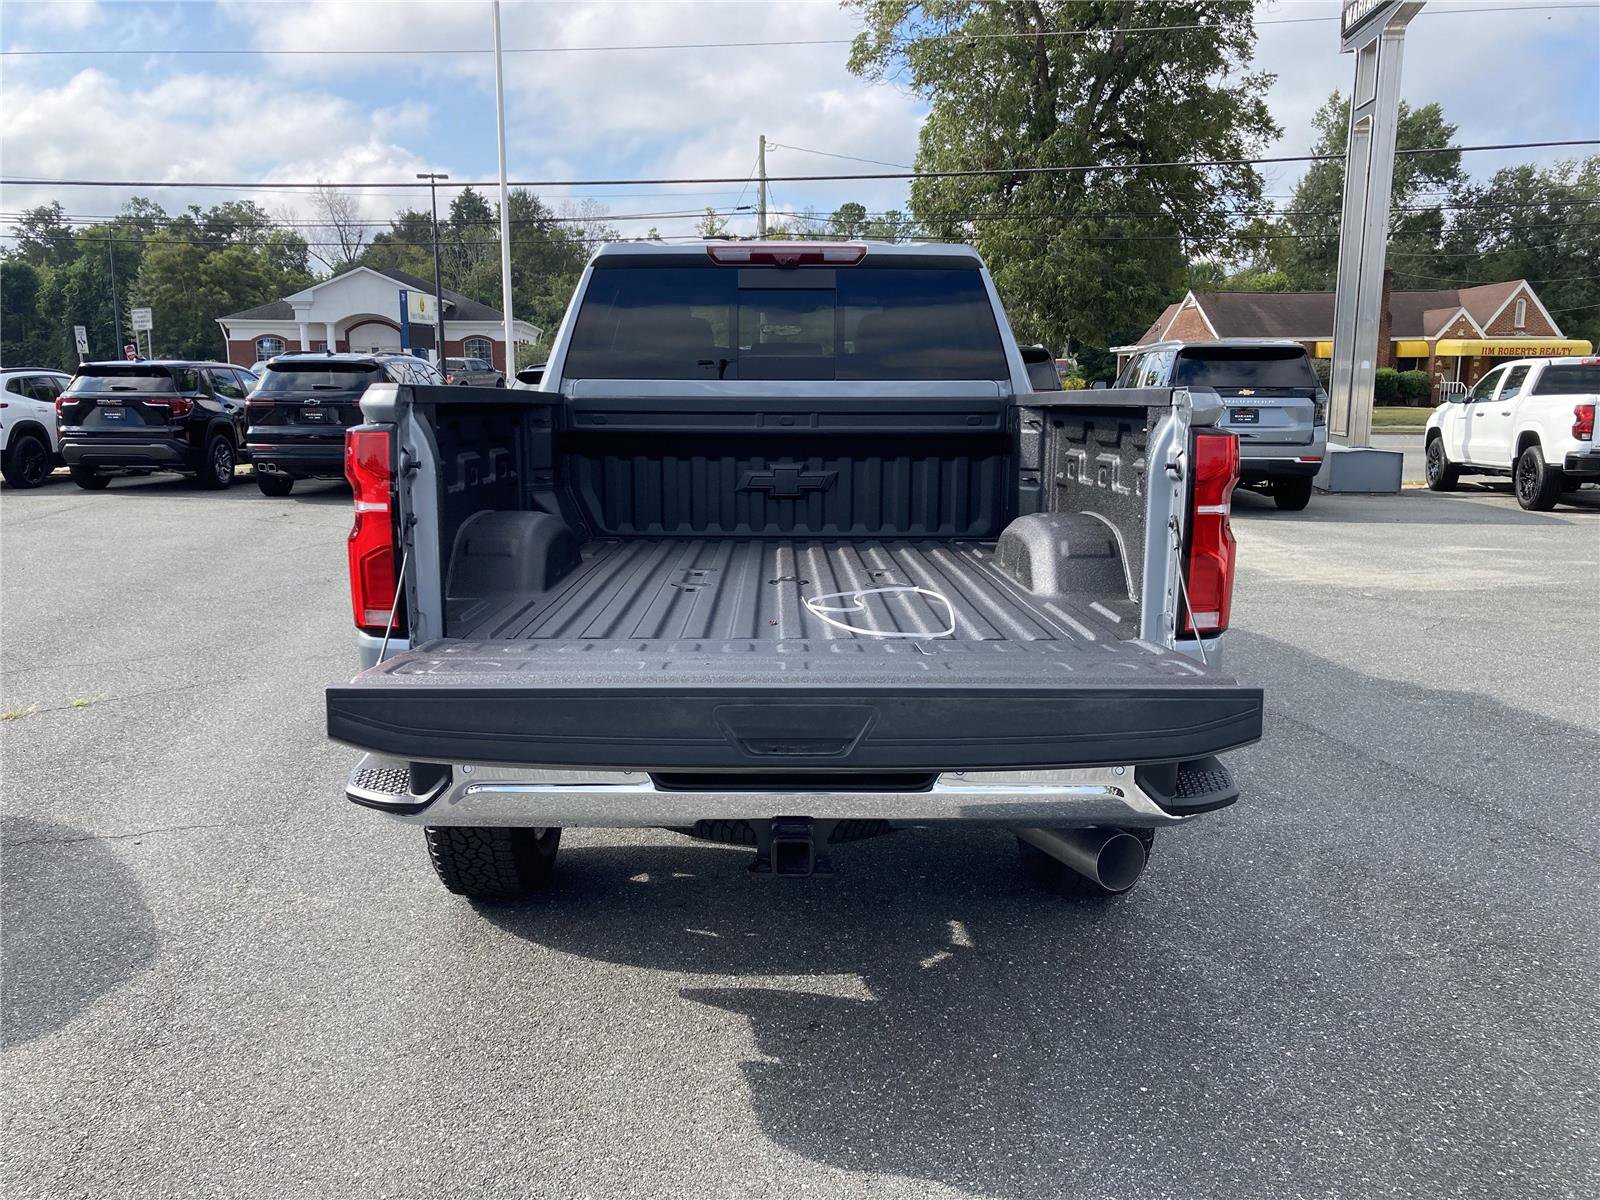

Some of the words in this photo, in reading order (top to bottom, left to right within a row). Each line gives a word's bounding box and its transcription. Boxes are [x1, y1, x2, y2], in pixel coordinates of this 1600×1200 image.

[1481, 347, 1495, 356] JIM
[1498, 347, 1538, 356] ROBERTS
[1539, 347, 1572, 356] REALTY
